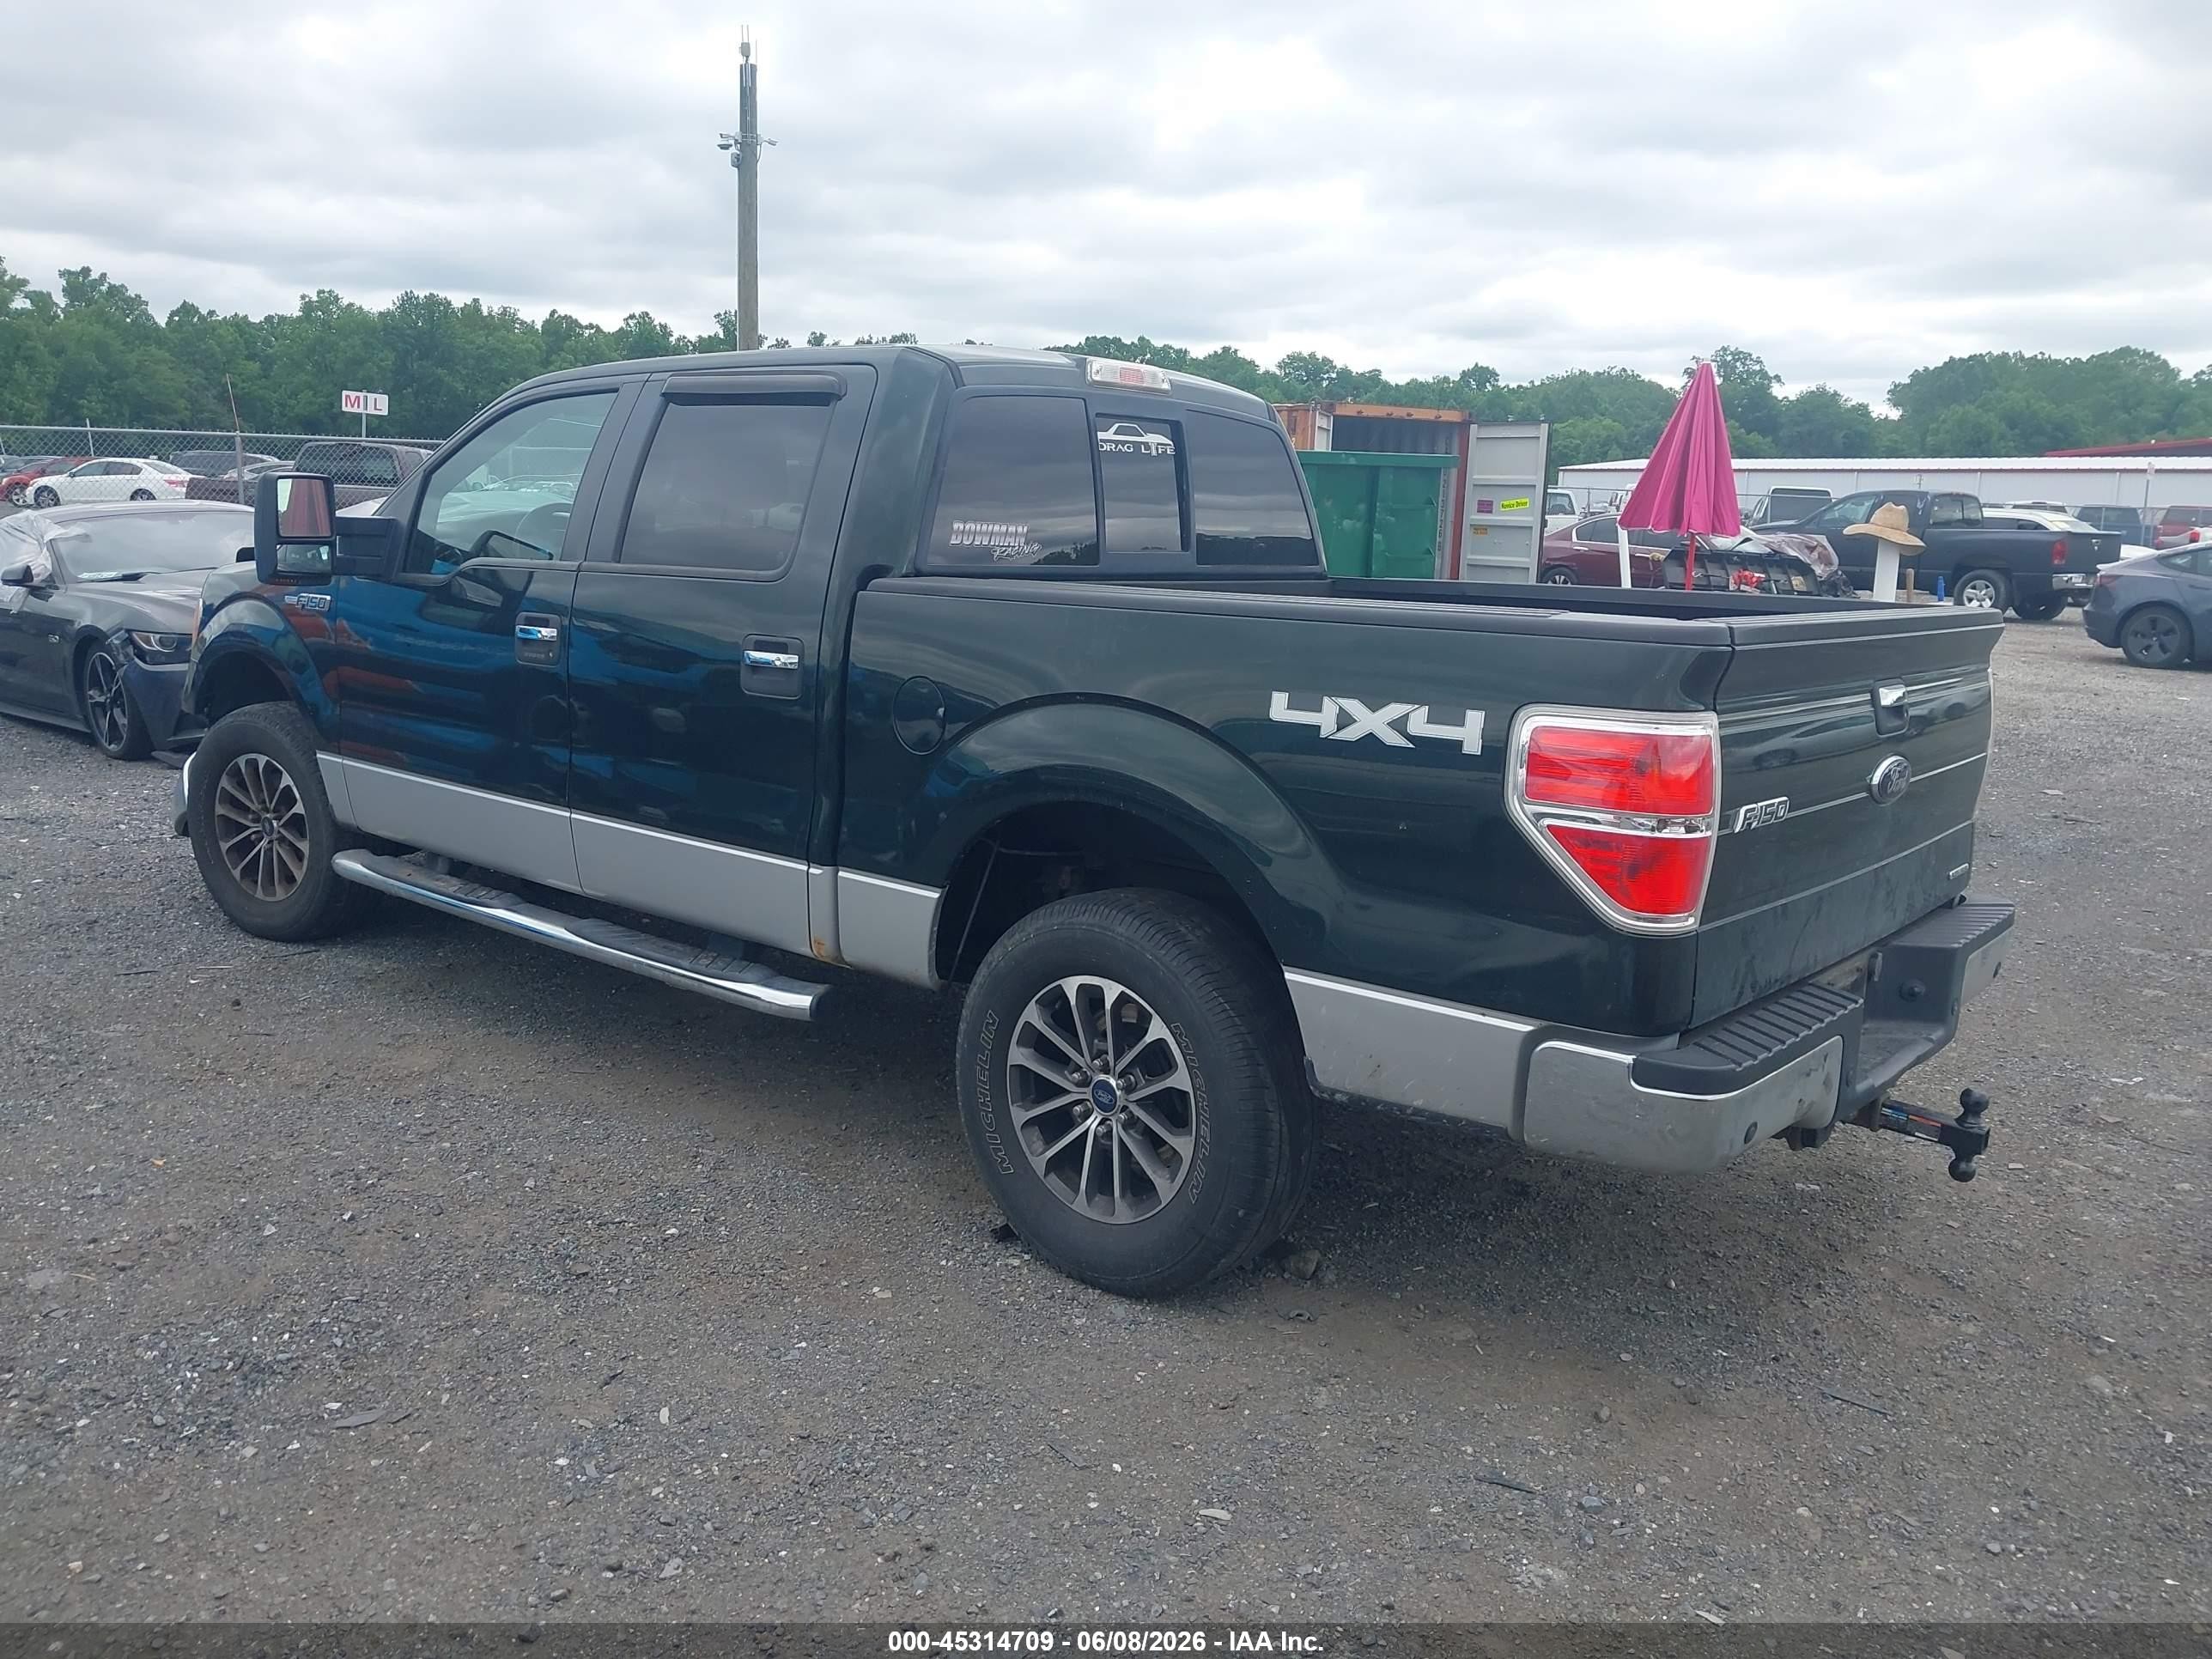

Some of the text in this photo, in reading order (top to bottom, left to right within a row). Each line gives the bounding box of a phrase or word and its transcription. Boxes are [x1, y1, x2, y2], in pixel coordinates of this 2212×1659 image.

[1098, 442, 1133, 453] DRAG
[949, 520, 1029, 547] BOWMAN
[991, 542, 1042, 562] RACING
[976, 1010, 1014, 1175] MICHELIN
[1170, 1023, 1211, 1204] MICHELIN
